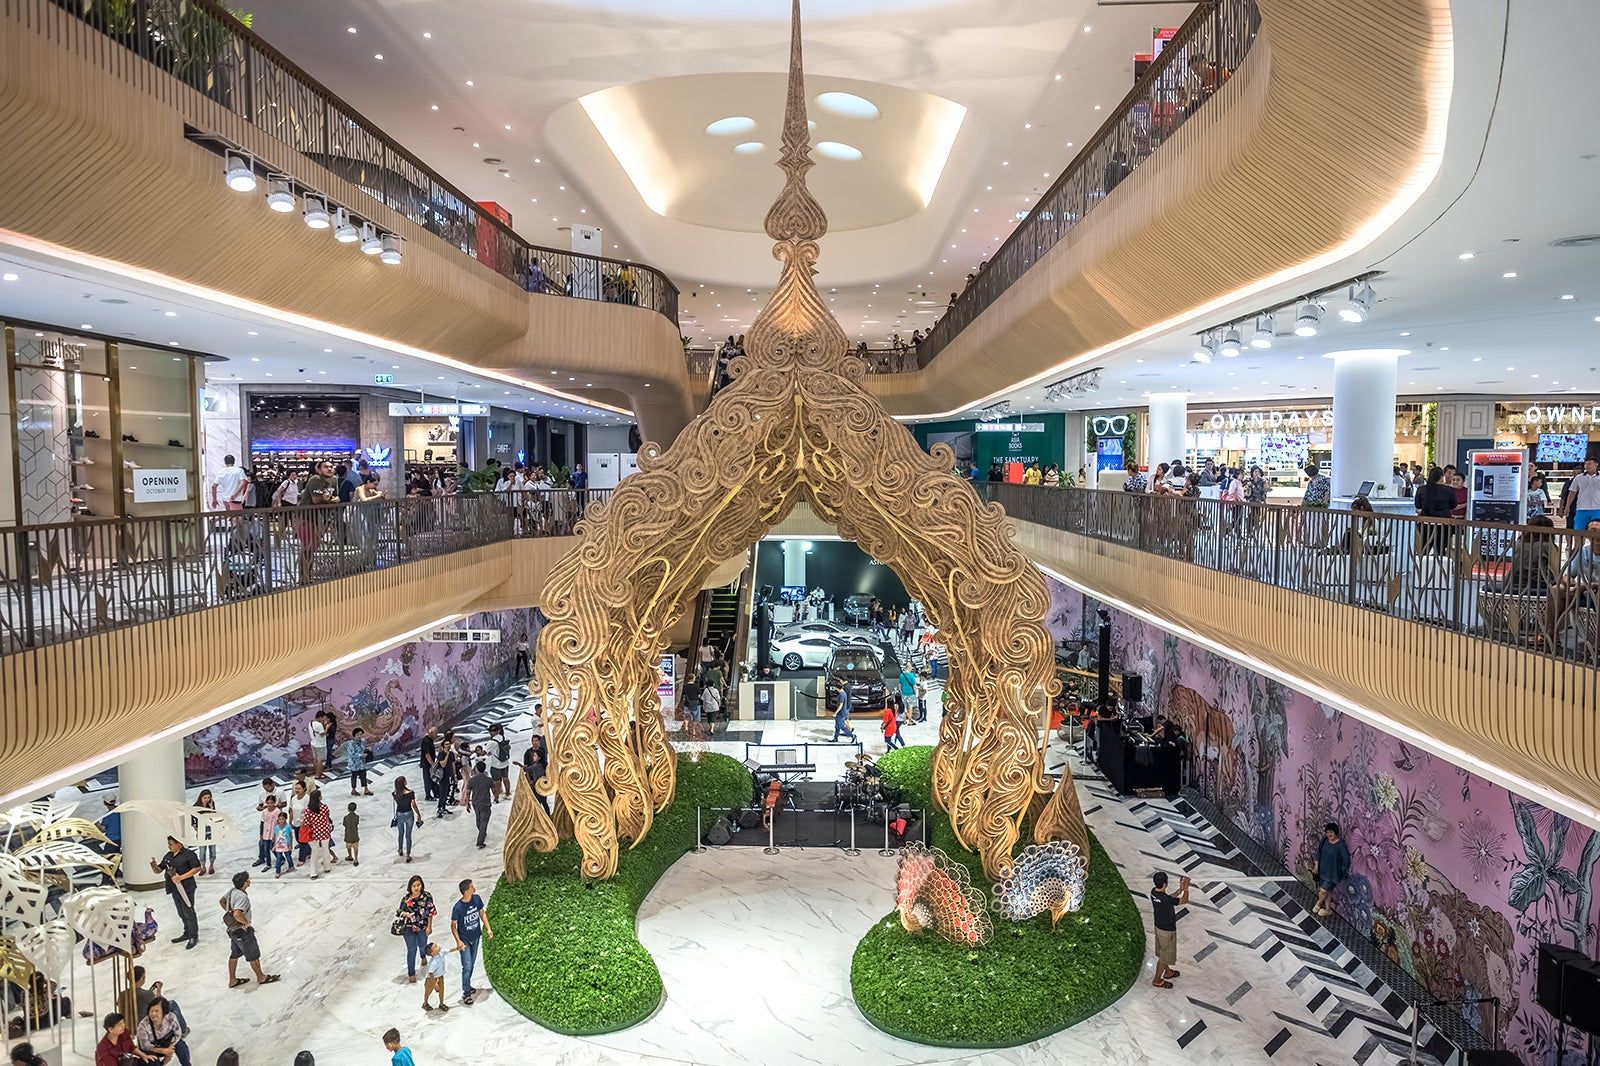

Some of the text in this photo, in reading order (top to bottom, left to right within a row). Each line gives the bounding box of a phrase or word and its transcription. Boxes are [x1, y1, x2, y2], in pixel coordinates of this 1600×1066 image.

[1211, 410, 1334, 430] OWNDAYS
[1004, 456, 1039, 464] SANCTUARY
[142, 477, 179, 486] OPENING
